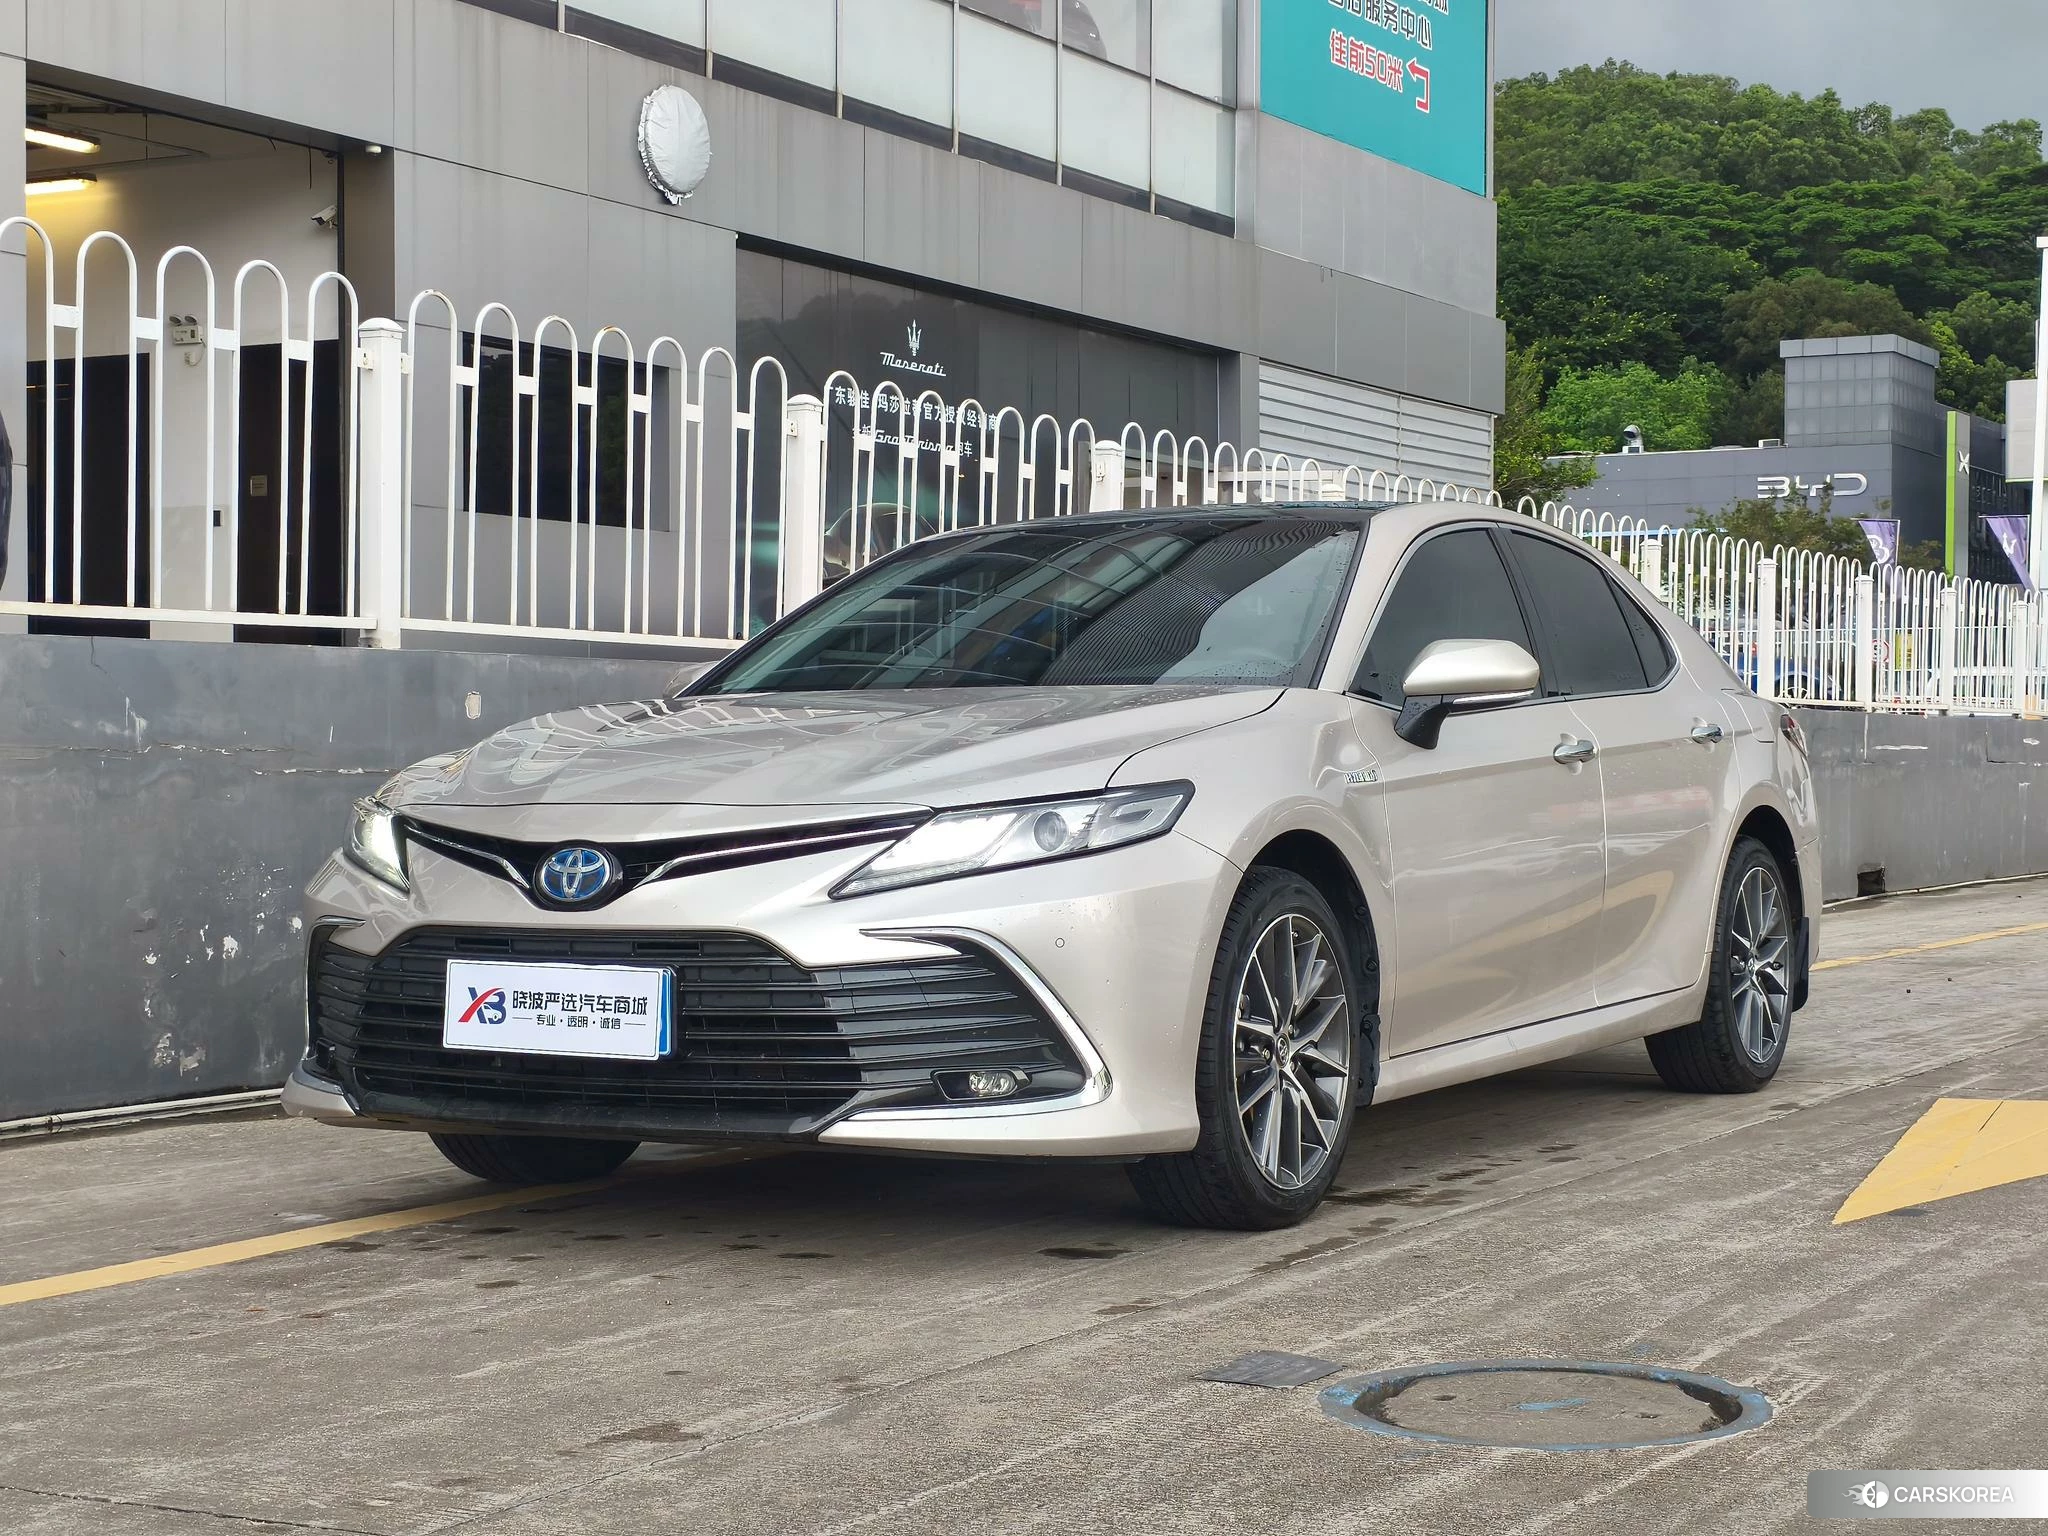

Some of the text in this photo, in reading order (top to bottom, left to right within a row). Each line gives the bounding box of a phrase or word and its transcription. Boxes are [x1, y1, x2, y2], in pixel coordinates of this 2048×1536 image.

[1327, 0, 1433, 50] 后服务中心
[879, 351, 947, 377] Maserati
[1757, 472, 1868, 499] BYD
[512, 990, 648, 1016] 晓波严选汽车商城
